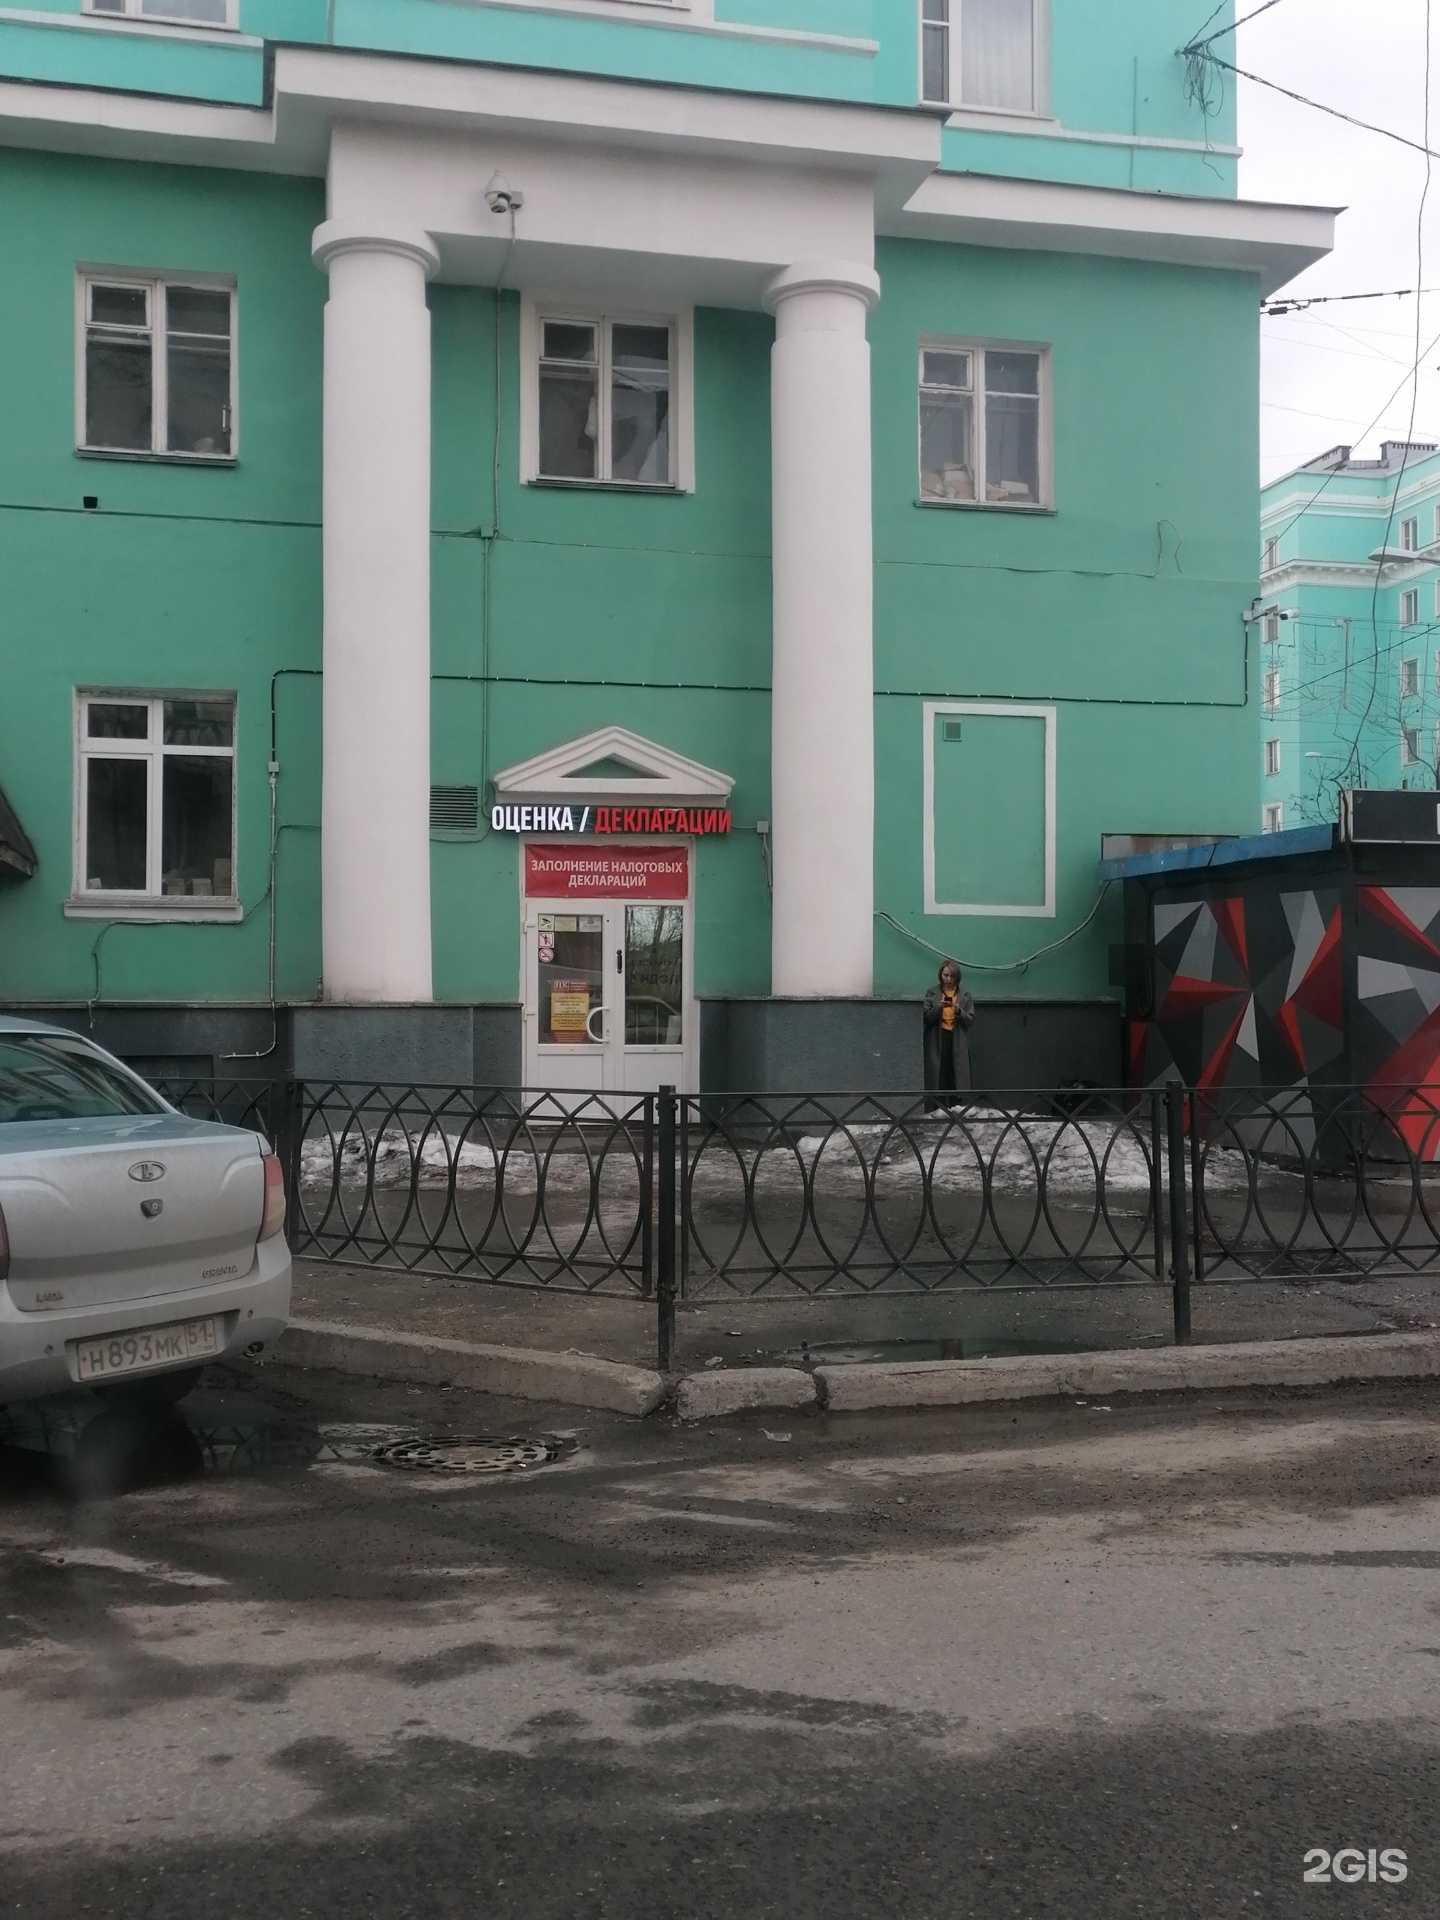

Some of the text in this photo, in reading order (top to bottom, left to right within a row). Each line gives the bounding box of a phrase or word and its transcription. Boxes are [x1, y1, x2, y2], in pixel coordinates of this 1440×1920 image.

[491, 805, 732, 834] ОЦЕНКА / ДЕКЛАРАЦИИ
[531, 859, 683, 873] ЗАПОЛНЕНИЕ НАЛОГОВЫХ
[568, 873, 646, 888] ДЕКЛАРАЦИЙ
